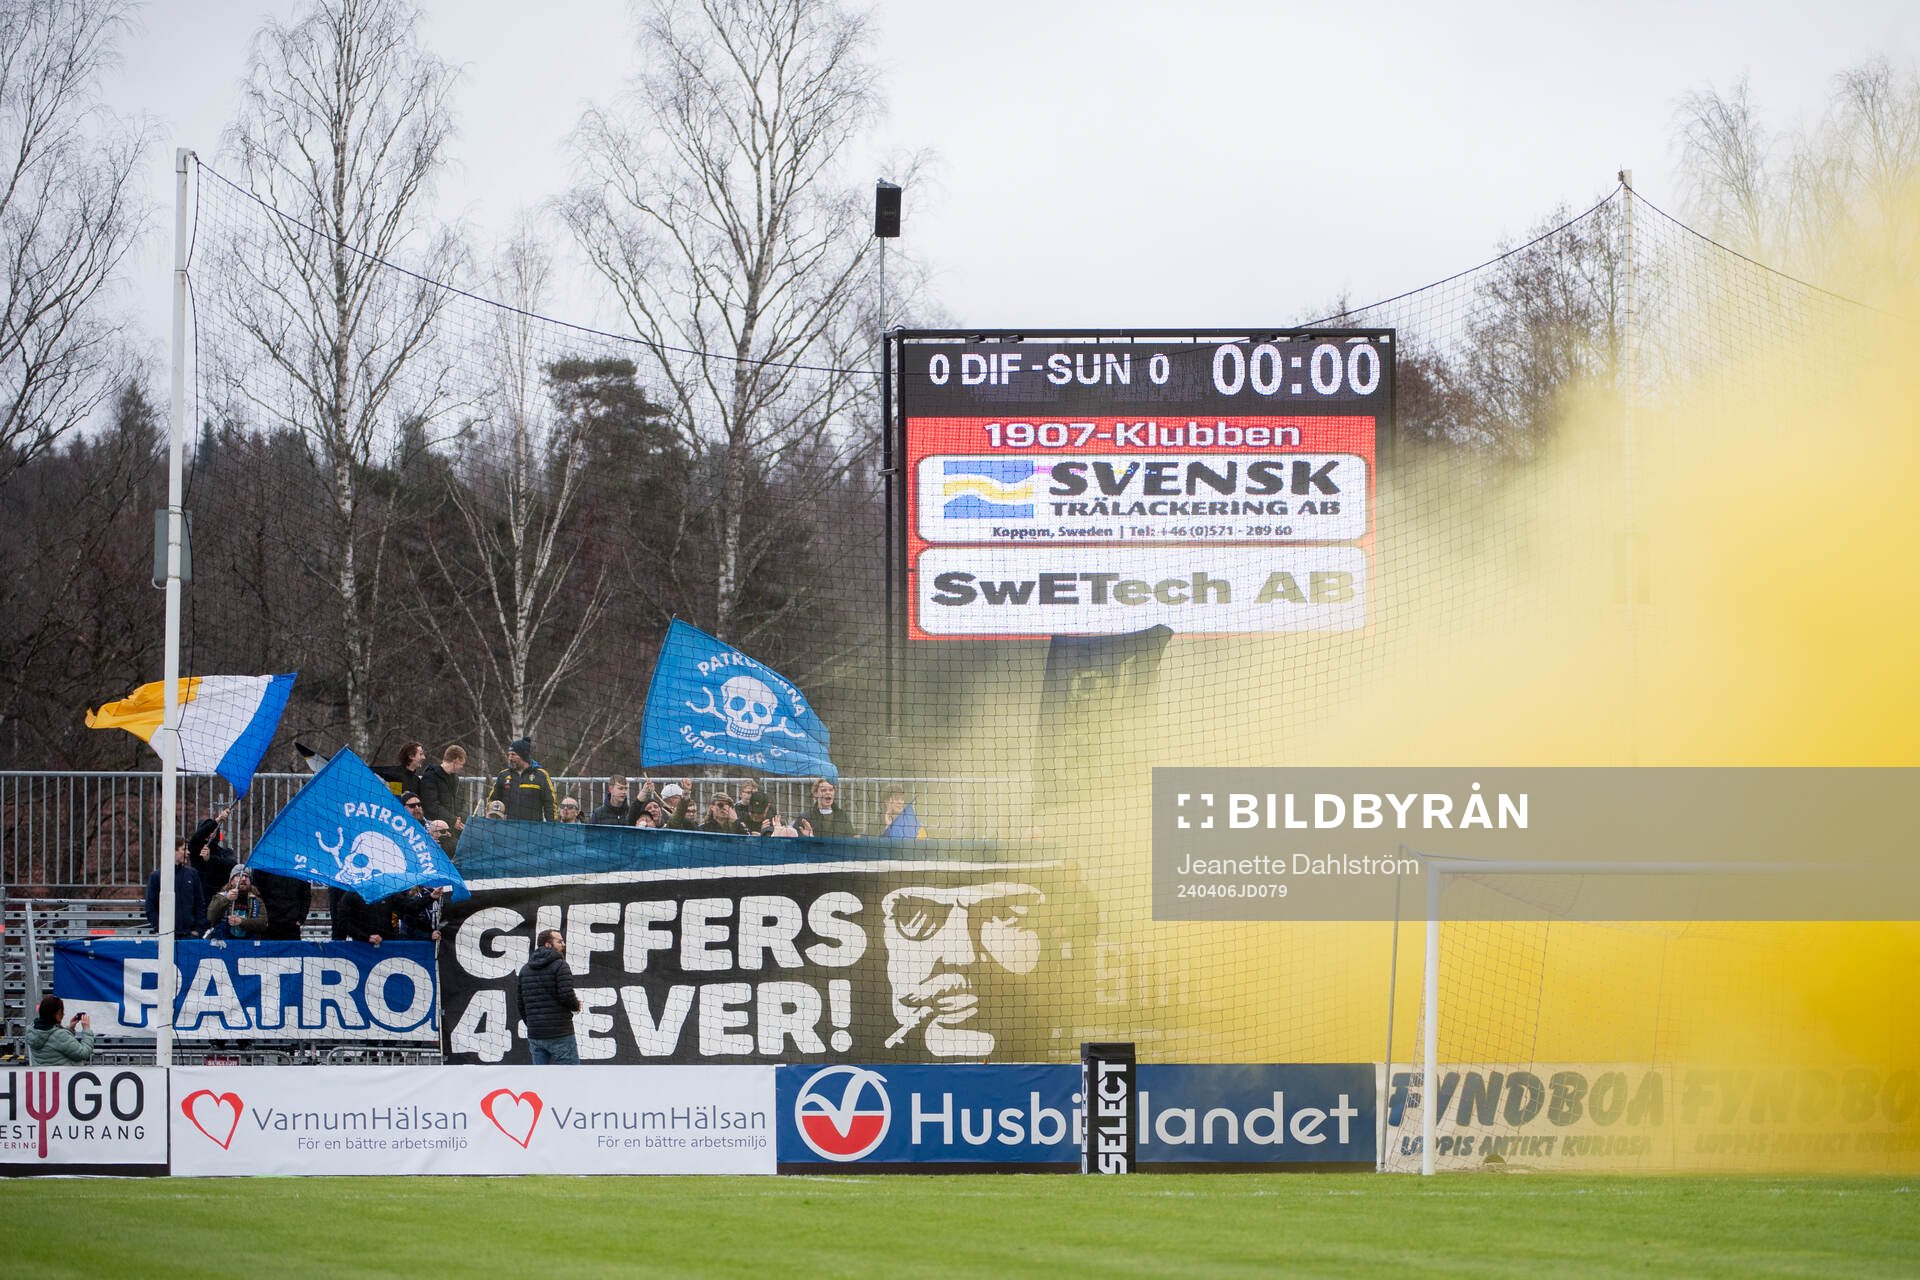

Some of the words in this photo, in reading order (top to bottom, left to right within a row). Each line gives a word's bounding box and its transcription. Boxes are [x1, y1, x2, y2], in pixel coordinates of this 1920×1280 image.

[929, 353, 950, 385] 0
[961, 353, 1022, 385] DIF
[1149, 353, 1170, 385] 0
[1213, 344, 1381, 396] 00:00
[984, 422, 1301, 448] 1907-Klubben
[1050, 461, 1341, 496] SVENSK
[1050, 497, 1289, 516] TRÄLACKERING
[1297, 501, 1341, 516] AB
[1058, 526, 1113, 537] Sweden
[1129, 525, 1155, 537] Tel:
[931, 571, 1232, 606] SwETech
[1255, 571, 1355, 605] AB
[697, 651, 806, 718] PATRRNA
[124, 957, 440, 1028] PATRO
[1388, 1071, 1665, 1127] FYNDBOA
[252, 1105, 468, 1131] VarnumHälsan
[551, 1105, 766, 1130] VarnumHälsan
[911, 1091, 1359, 1145] Husbilandet
[1098, 1060, 1127, 1174] SELECT
[298, 1137, 320, 1149] För
[324, 1141, 341, 1149] en
[345, 1137, 387, 1149] bättre
[391, 1137, 468, 1151] arbetsmiljö
[597, 1135, 619, 1148] För
[624, 1139, 641, 1148] en
[645, 1135, 686, 1148] bättre
[690, 1135, 767, 1150] arbetsmiljö
[1401, 1135, 1475, 1156] LOPIS
